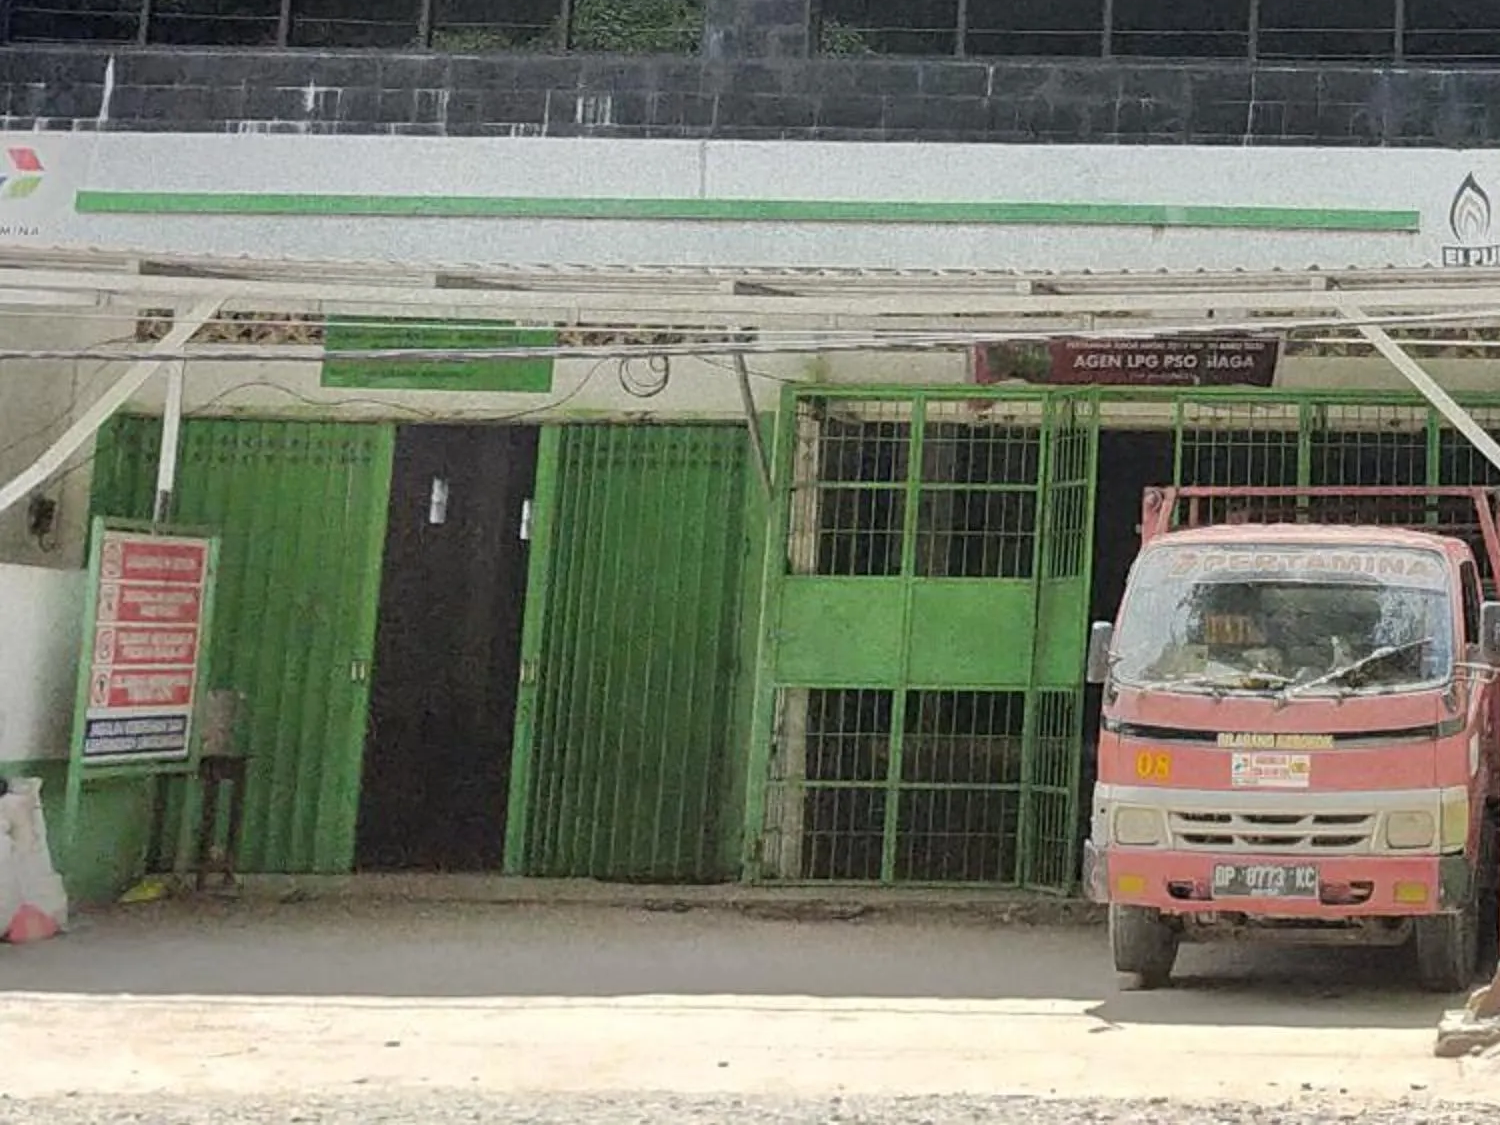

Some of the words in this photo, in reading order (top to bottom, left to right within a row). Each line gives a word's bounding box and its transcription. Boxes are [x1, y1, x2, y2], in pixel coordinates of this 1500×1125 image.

[1073, 353, 1121, 369] AGEN
[1127, 354, 1159, 369] LPG
[1163, 354, 1199, 369] PSO
[1203, 553, 1431, 577] PERTAMINA
[1295, 866, 1316, 888] KC
